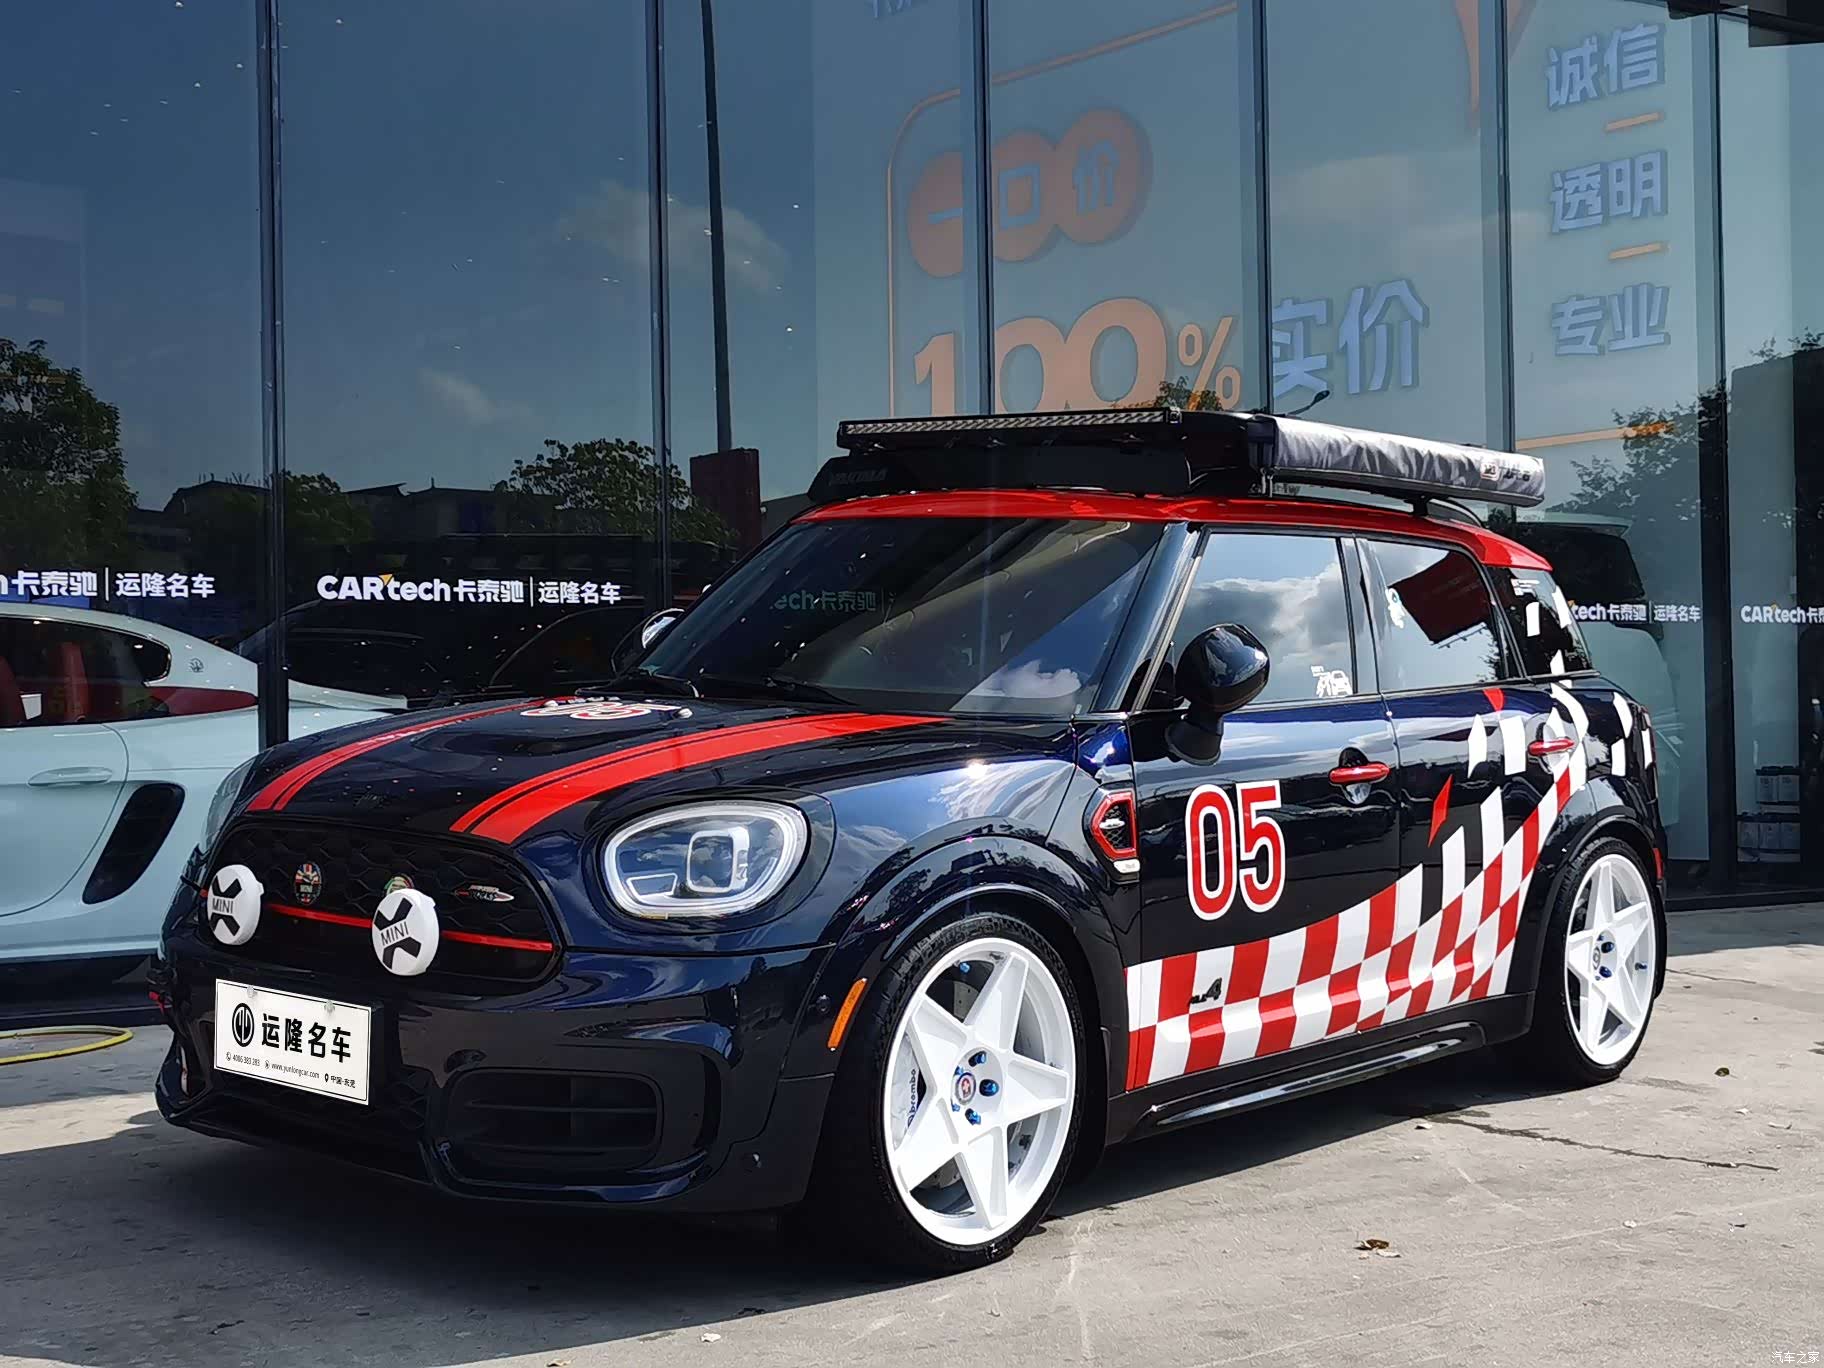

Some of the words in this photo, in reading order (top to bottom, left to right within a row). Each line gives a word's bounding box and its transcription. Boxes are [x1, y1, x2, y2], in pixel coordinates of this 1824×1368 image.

[1547, 24, 1660, 108] 诚信
[1551, 151, 1663, 233] 透明
[1552, 283, 1667, 357] 专业
[913, 297, 1242, 413] 100%
[1271, 279, 1424, 399] 实价
[115, 573, 216, 598] 运隆名车
[538, 581, 622, 605] 运隆名车
[1653, 604, 1701, 622] 运隆名车
[1185, 780, 1286, 921] 05
[212, 897, 234, 914] MINI
[381, 922, 409, 946] MINI
[261, 1013, 352, 1064] 运隆名车
